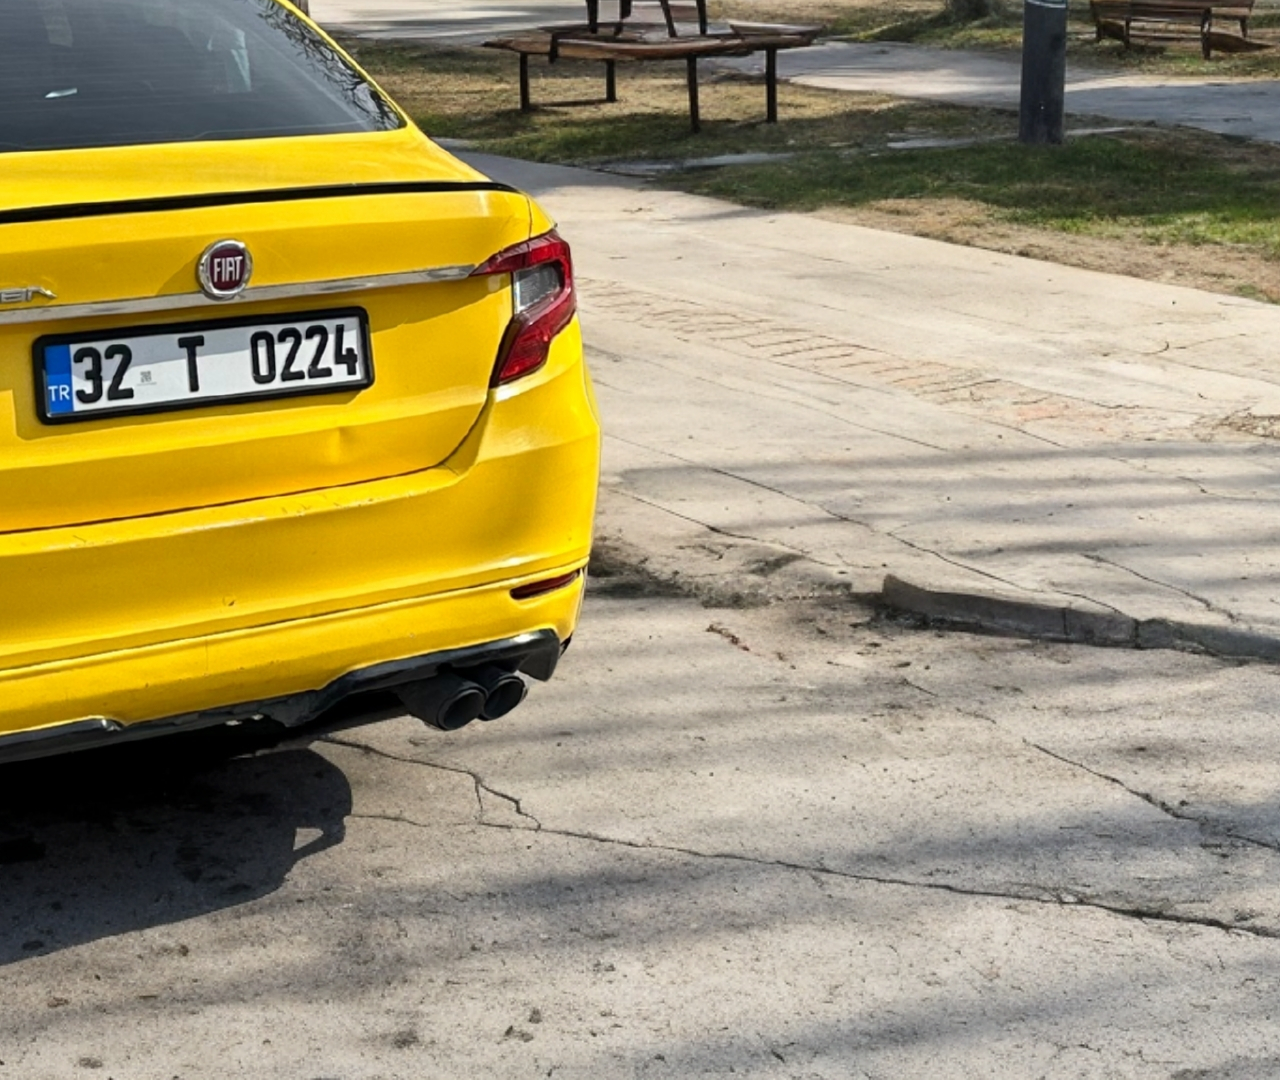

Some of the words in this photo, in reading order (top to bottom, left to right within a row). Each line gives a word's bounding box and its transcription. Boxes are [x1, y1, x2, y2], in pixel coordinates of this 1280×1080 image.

[213, 255, 243, 283] FIAT
[73, 344, 135, 405] 32
[178, 335, 205, 392] T
[250, 324, 358, 385] 0224
[48, 384, 70, 401] TR
